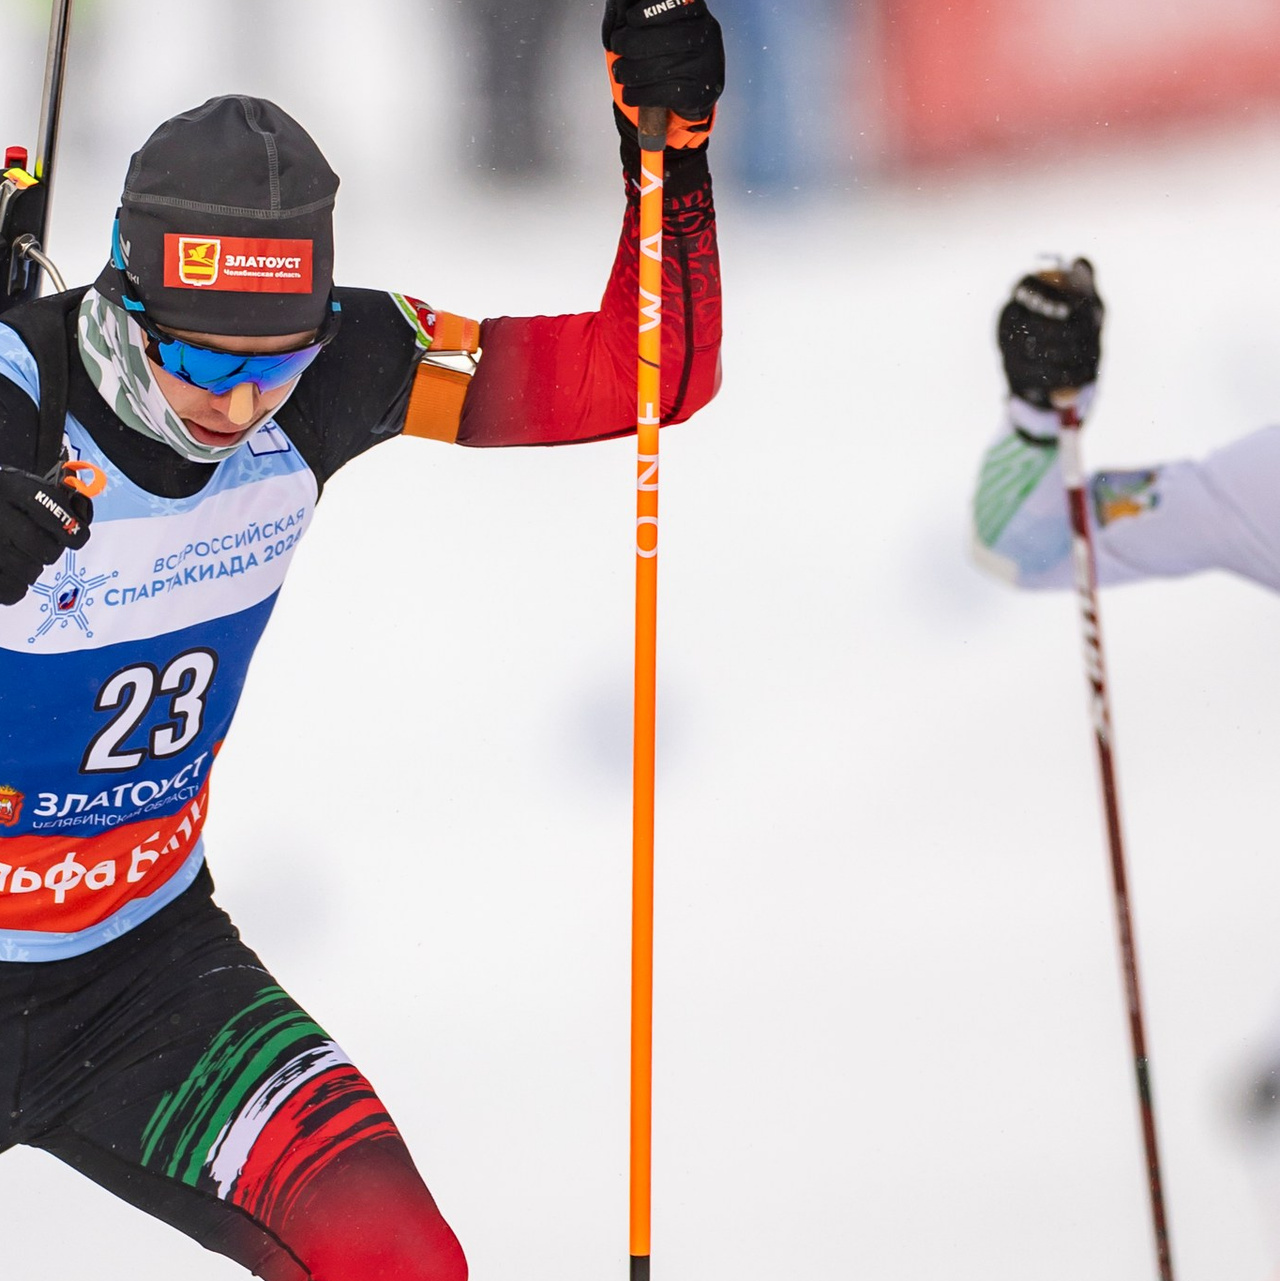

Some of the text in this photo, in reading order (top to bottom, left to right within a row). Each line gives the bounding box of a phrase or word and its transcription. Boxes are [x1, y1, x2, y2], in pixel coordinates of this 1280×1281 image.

[223, 268, 301, 279] Челябинская область
[225, 254, 301, 269] ЗЛАТОУСТ
[639, 164, 663, 333] WAY
[104, 552, 259, 607] СПАРТАКИАДА
[80, 647, 217, 774] 23
[33, 752, 208, 818] ЗЛАТОУСТ
